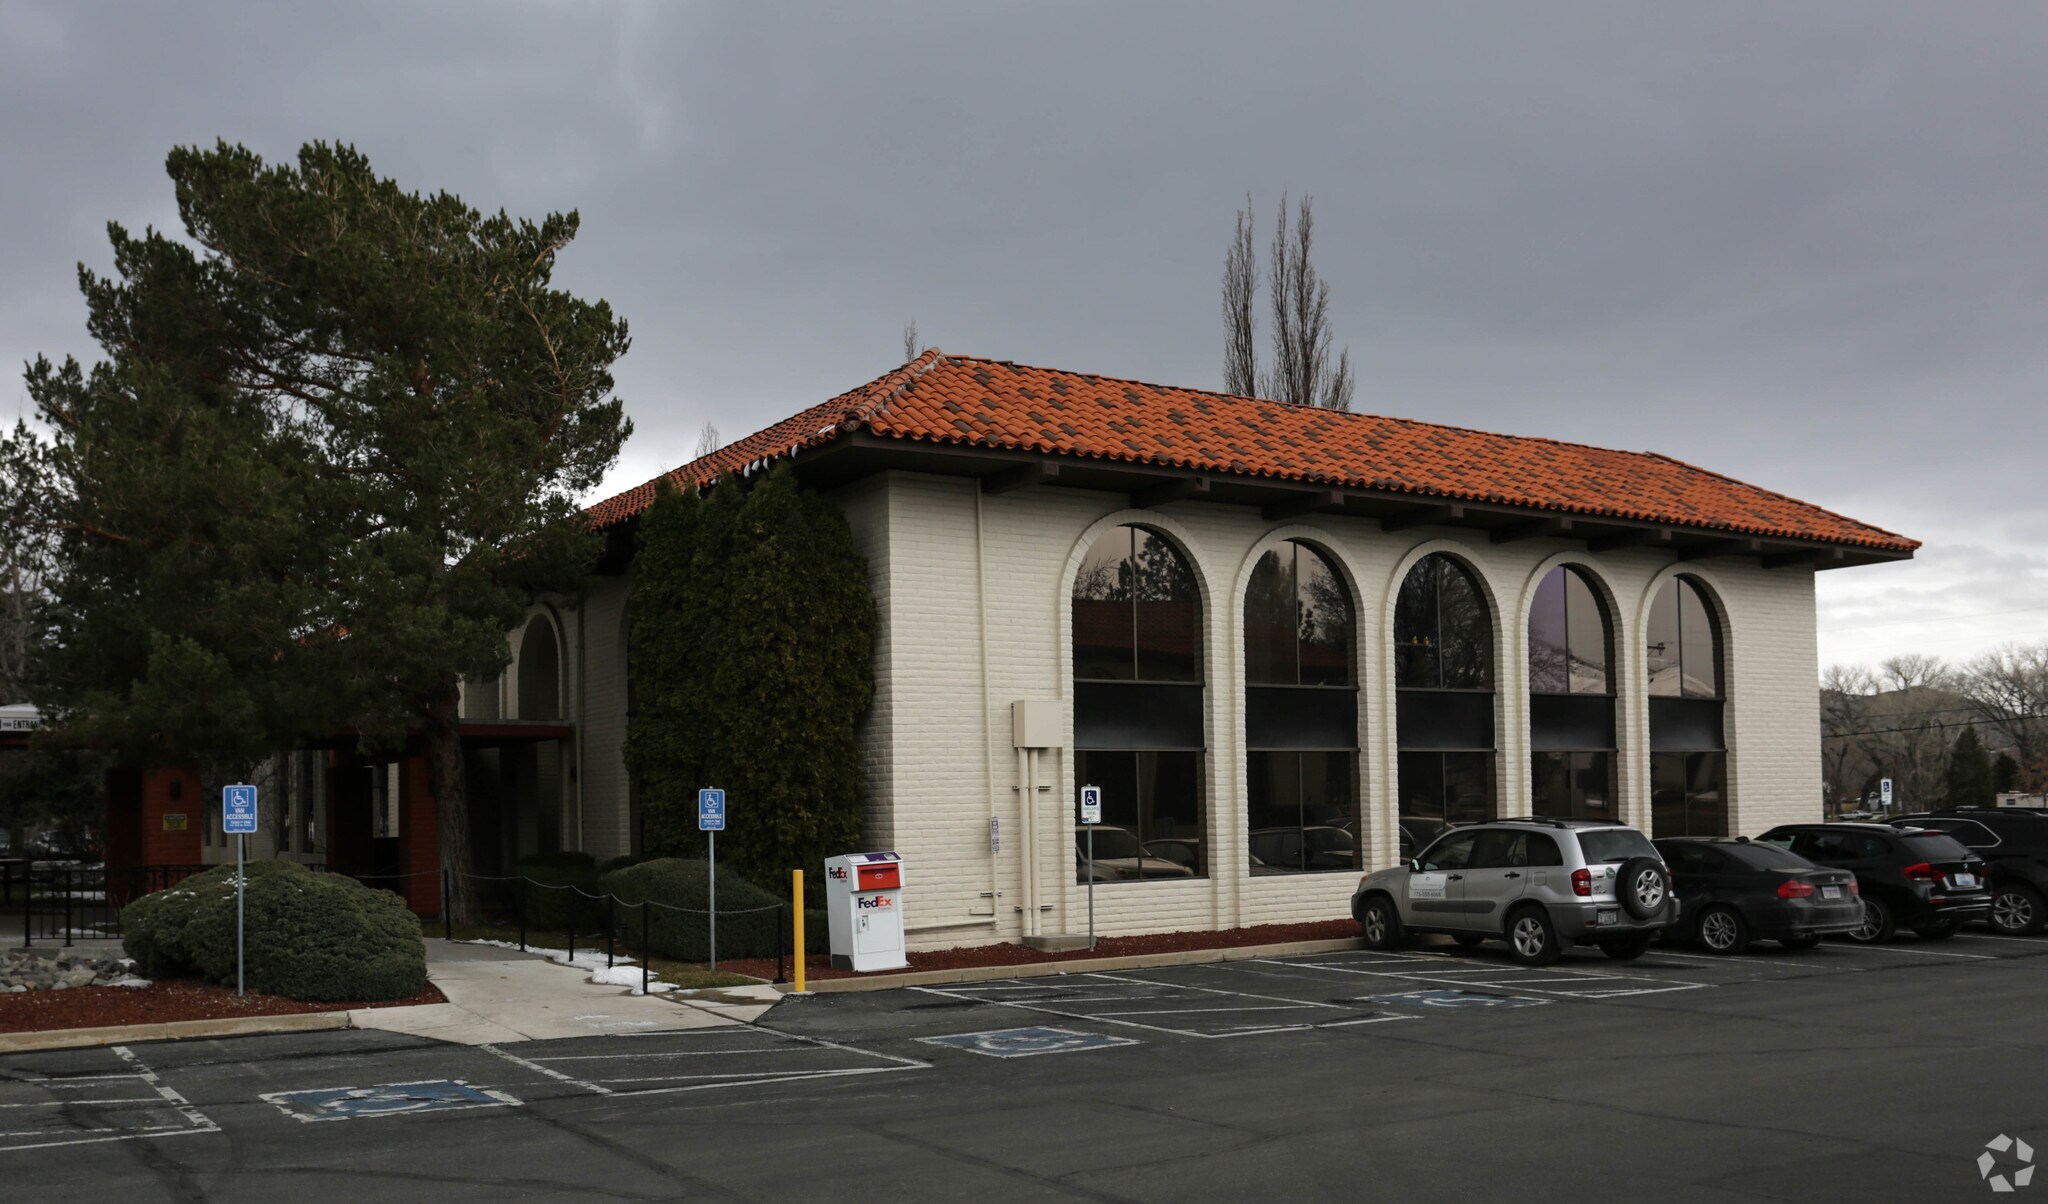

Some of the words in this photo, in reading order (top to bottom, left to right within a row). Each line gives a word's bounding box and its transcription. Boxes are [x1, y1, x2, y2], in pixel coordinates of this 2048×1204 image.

[13, 719, 41, 729] ENTRAN
[829, 867, 848, 879] FedEx
[858, 895, 892, 909] FedEx
